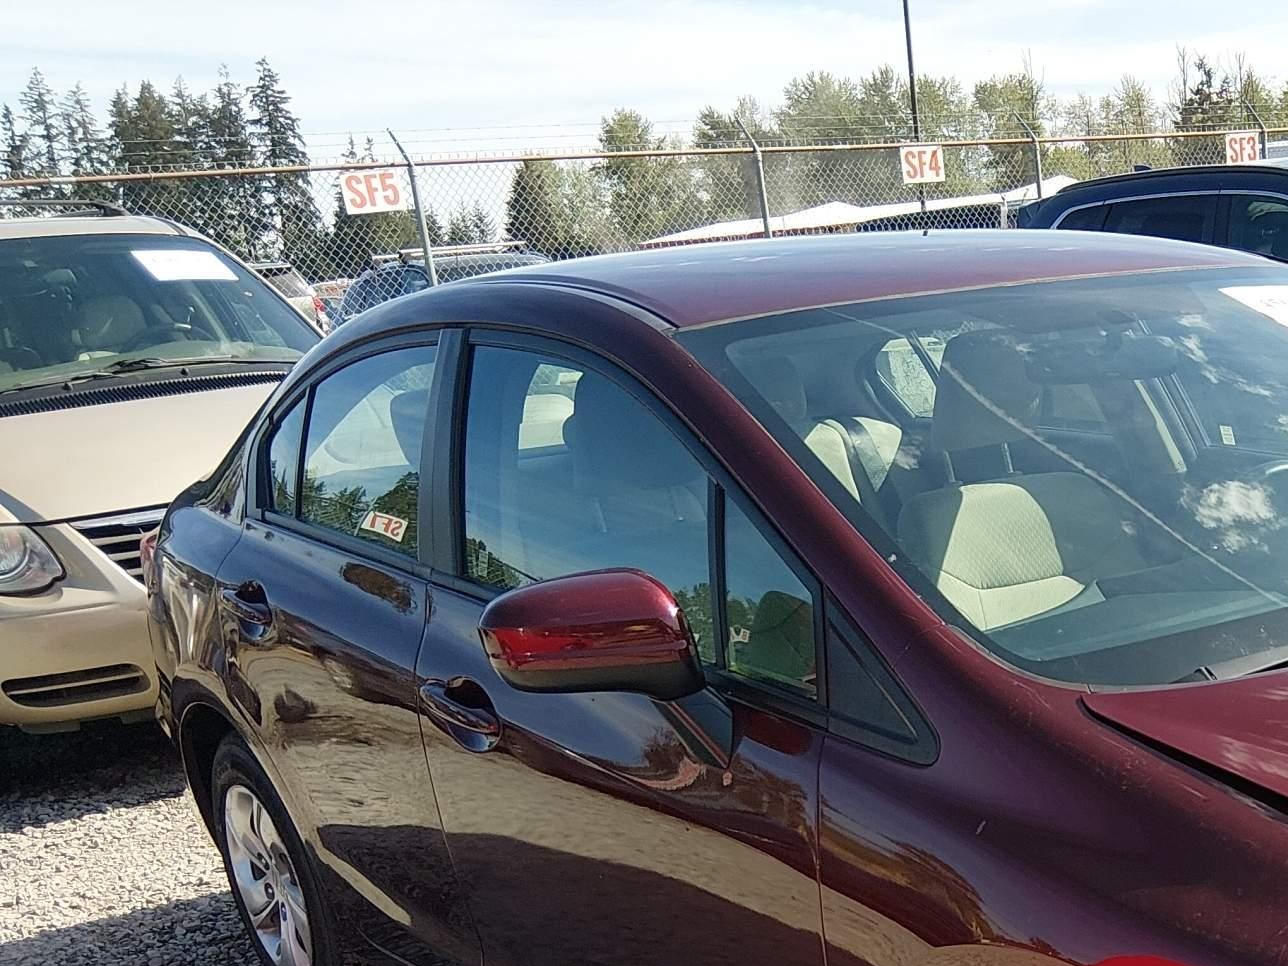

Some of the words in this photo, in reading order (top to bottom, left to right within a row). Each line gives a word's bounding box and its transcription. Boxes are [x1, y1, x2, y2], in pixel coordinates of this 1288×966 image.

[1229, 136, 1257, 163] SF3
[905, 150, 941, 179] SF4
[345, 172, 400, 208] SF5
